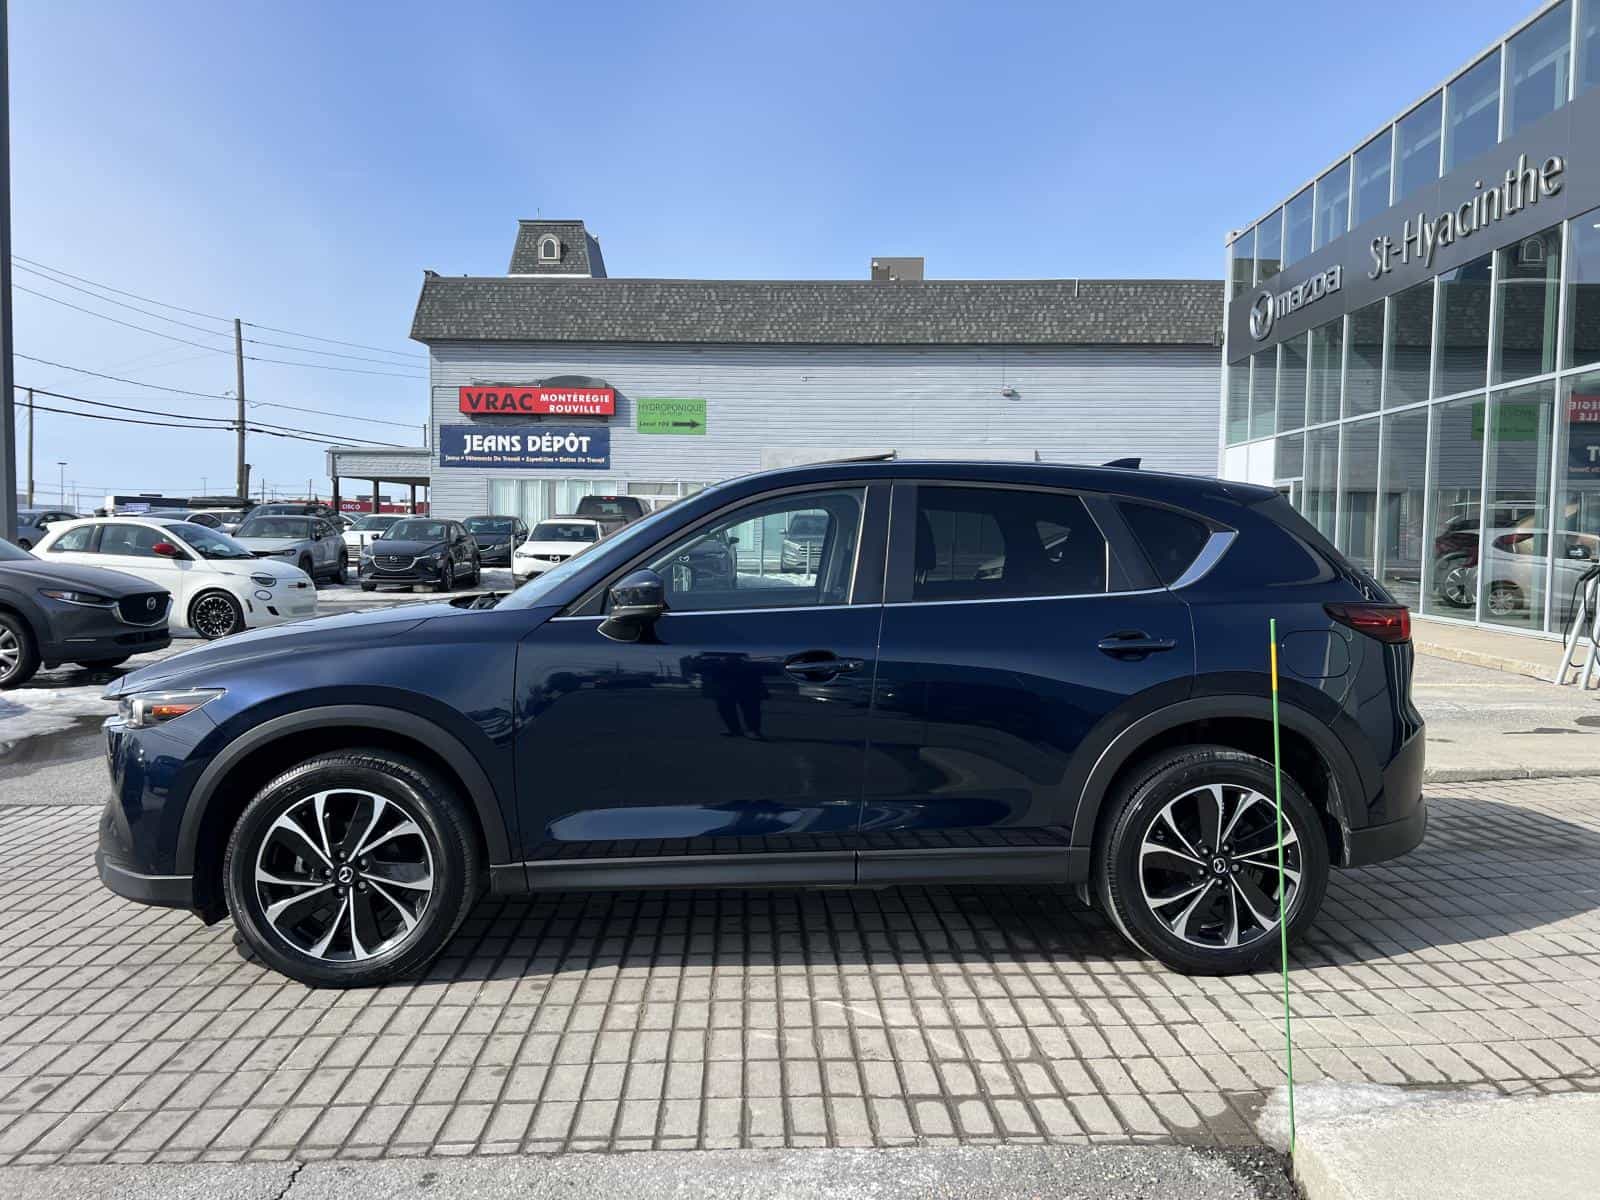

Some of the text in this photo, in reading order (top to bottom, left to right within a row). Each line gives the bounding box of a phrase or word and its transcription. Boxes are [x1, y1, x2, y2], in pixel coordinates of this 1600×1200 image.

[1368, 152, 1567, 280] St-Hyacinthe
[467, 393, 533, 410] VRAC
[540, 393, 609, 403] MONTÉRÉGIE
[549, 404, 600, 413] ROUVILLE
[463, 432, 591, 454] JEANS DÉPÔT
